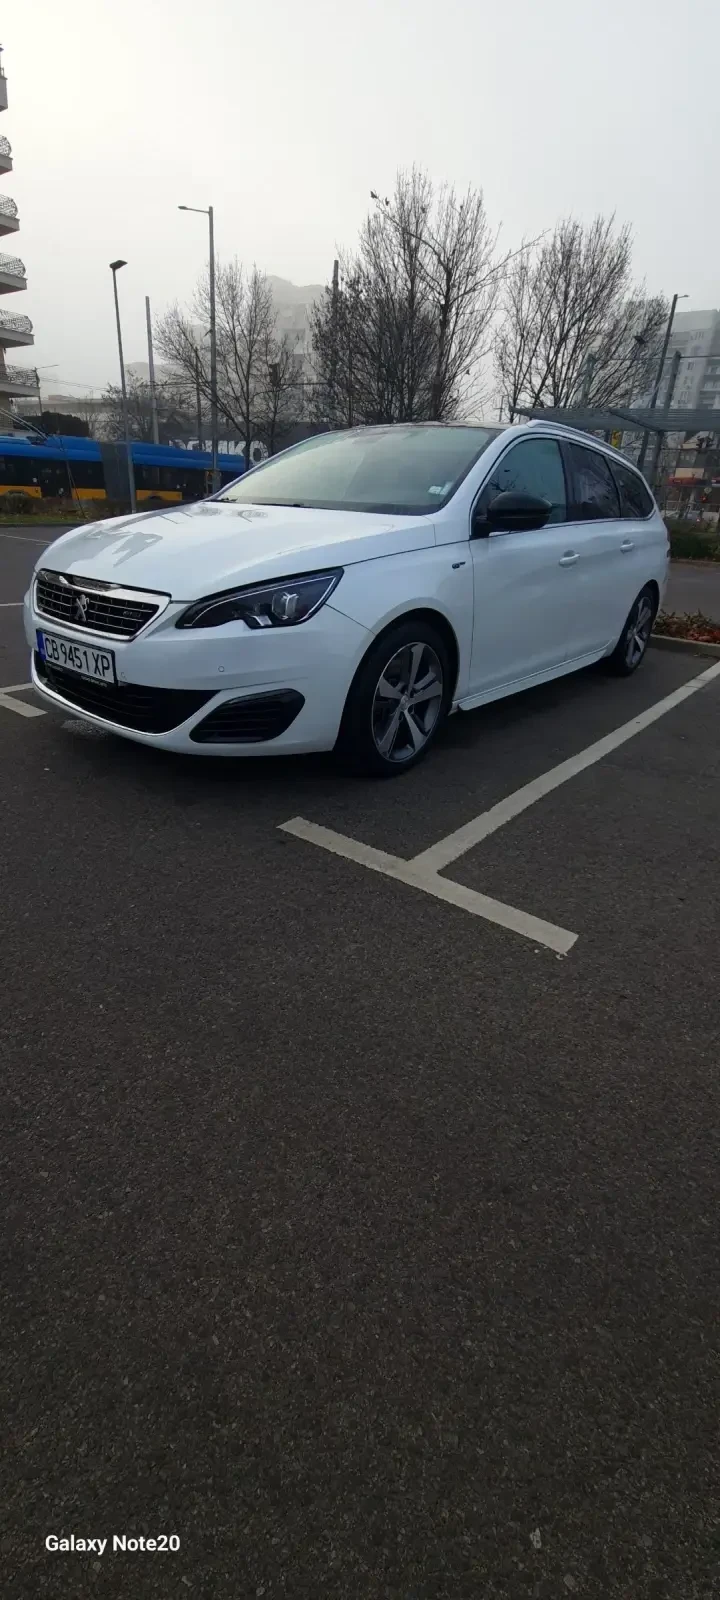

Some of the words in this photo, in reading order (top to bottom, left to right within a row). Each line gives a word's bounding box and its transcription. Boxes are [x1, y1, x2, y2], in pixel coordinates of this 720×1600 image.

[44, 637, 60, 661] CB
[60, 643, 90, 672] 9451
[91, 651, 110, 677] XP
